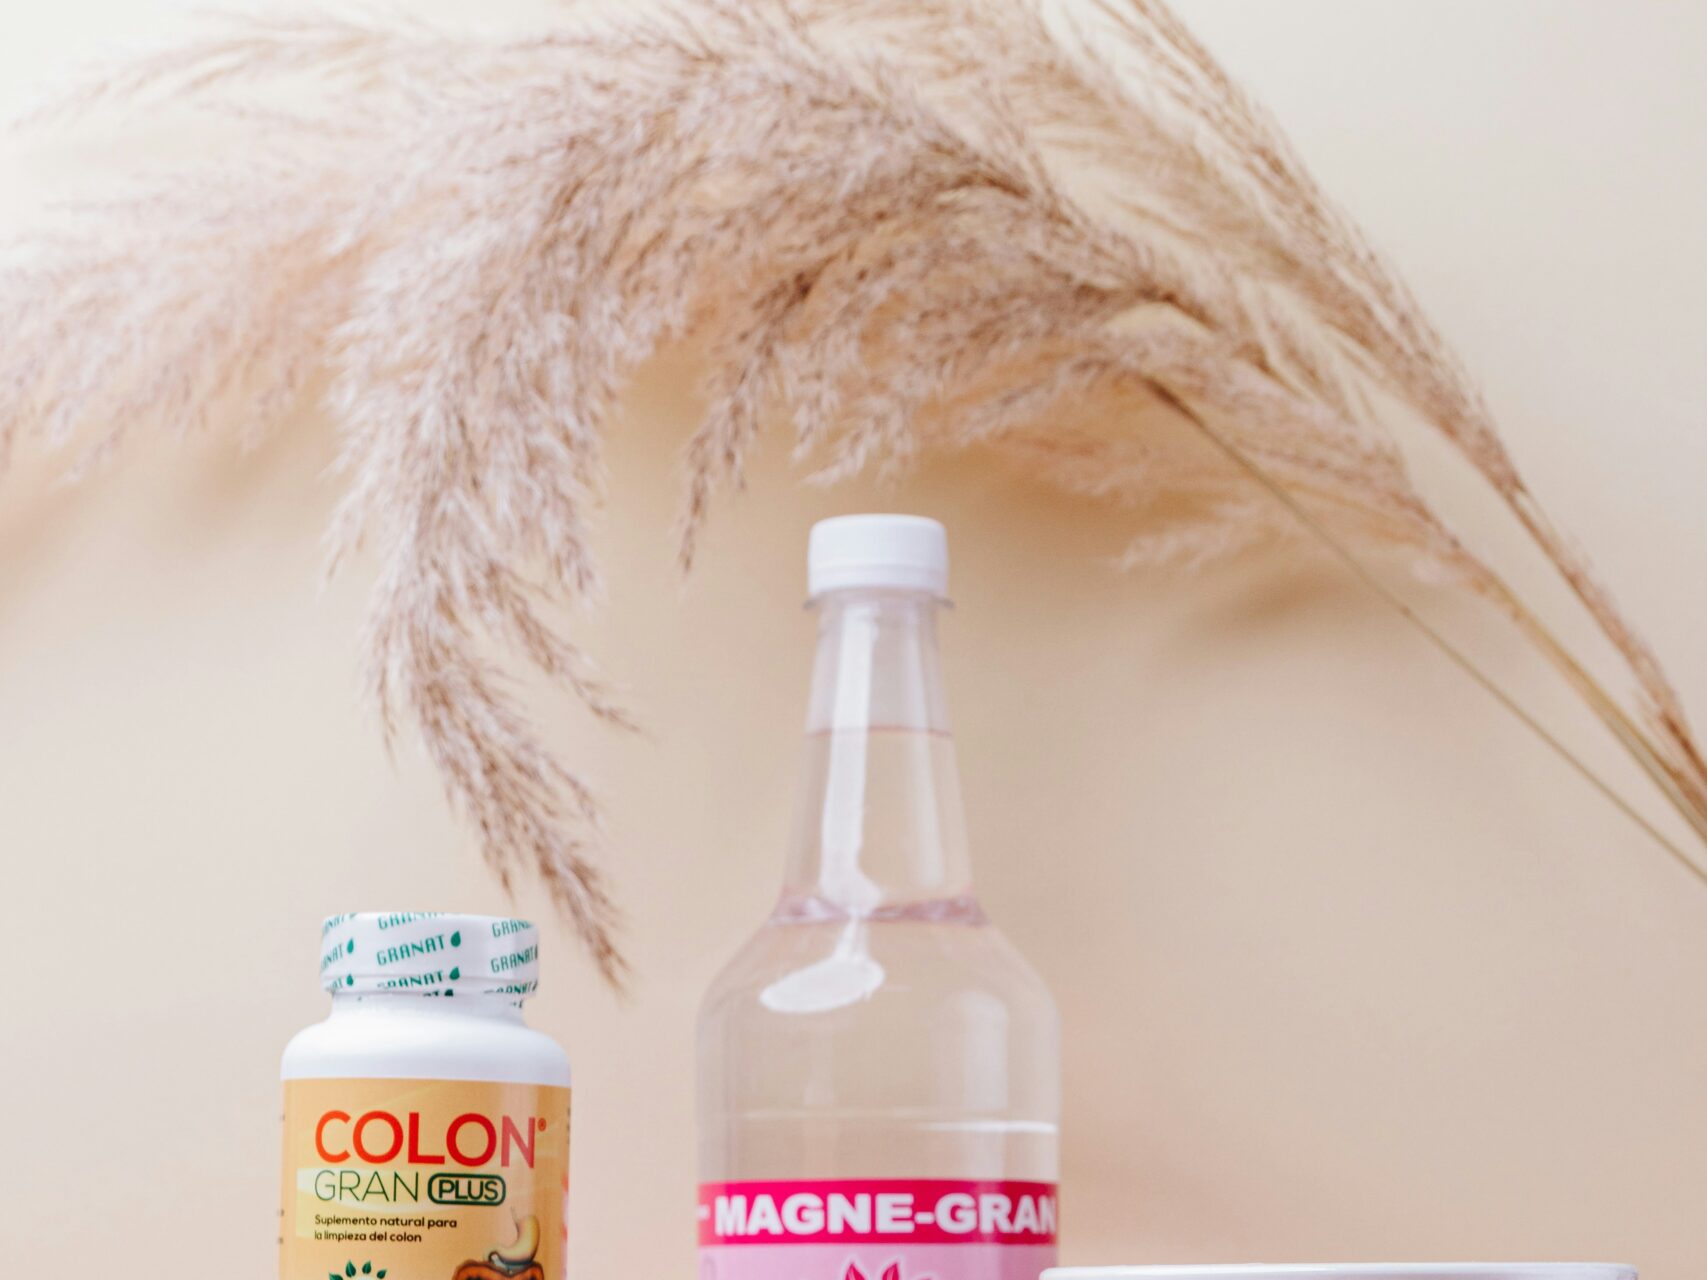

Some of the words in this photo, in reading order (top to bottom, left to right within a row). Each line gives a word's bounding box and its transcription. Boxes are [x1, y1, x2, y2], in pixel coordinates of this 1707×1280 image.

[377, 934, 444, 966] GRANAT
[490, 945, 534, 973] GRANAT
[314, 1169, 419, 1202] GRAN
[438, 1179, 499, 1200] PLUS
[314, 1214, 377, 1228] Suplemento
[380, 1216, 425, 1228] natural
[427, 1218, 457, 1229] para
[714, 1192, 1057, 1236] MAGNE-GRAN
[314, 1230, 322, 1241] la
[324, 1230, 367, 1243] limpieza
[369, 1231, 387, 1242] del
[389, 1232, 422, 1242] colon
